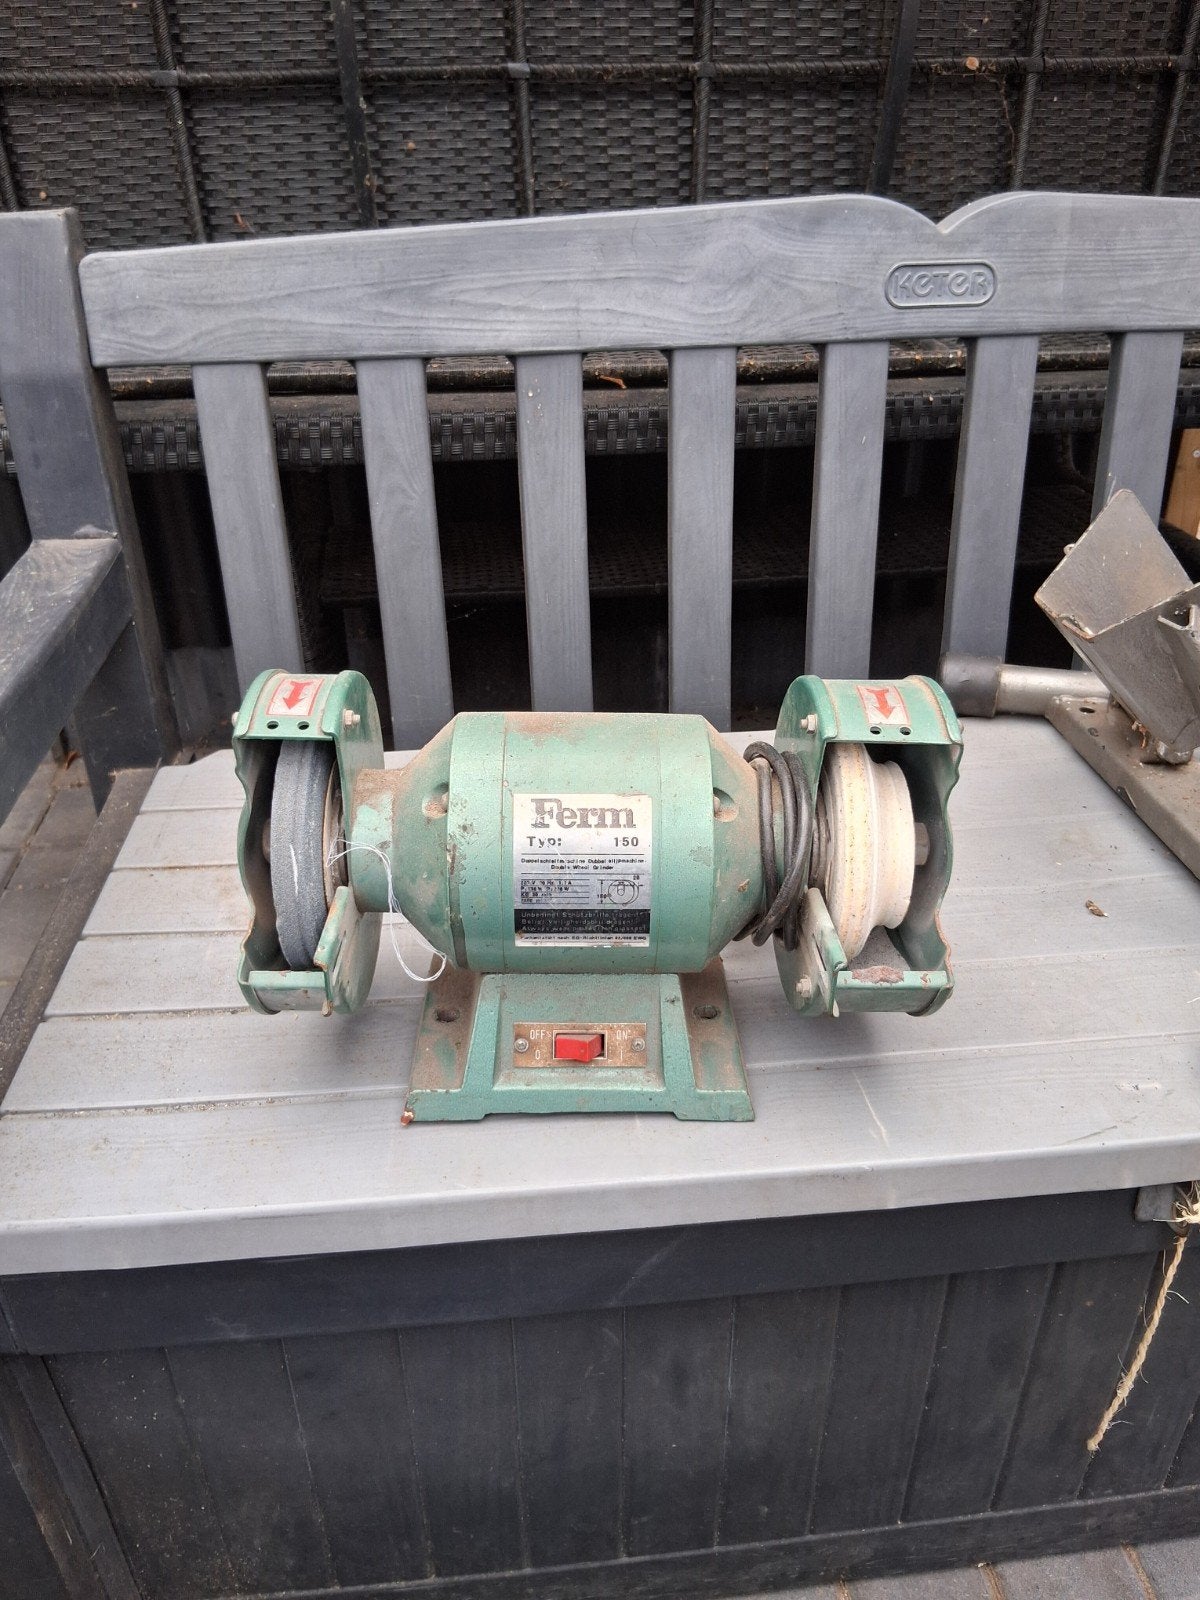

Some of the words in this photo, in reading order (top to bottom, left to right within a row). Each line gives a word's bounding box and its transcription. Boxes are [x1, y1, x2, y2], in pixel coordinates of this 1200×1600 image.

[530, 797, 637, 829] Ferm
[613, 836, 639, 847] 150
[529, 1029, 546, 1040] OFF
[616, 1029, 629, 1040] ON
